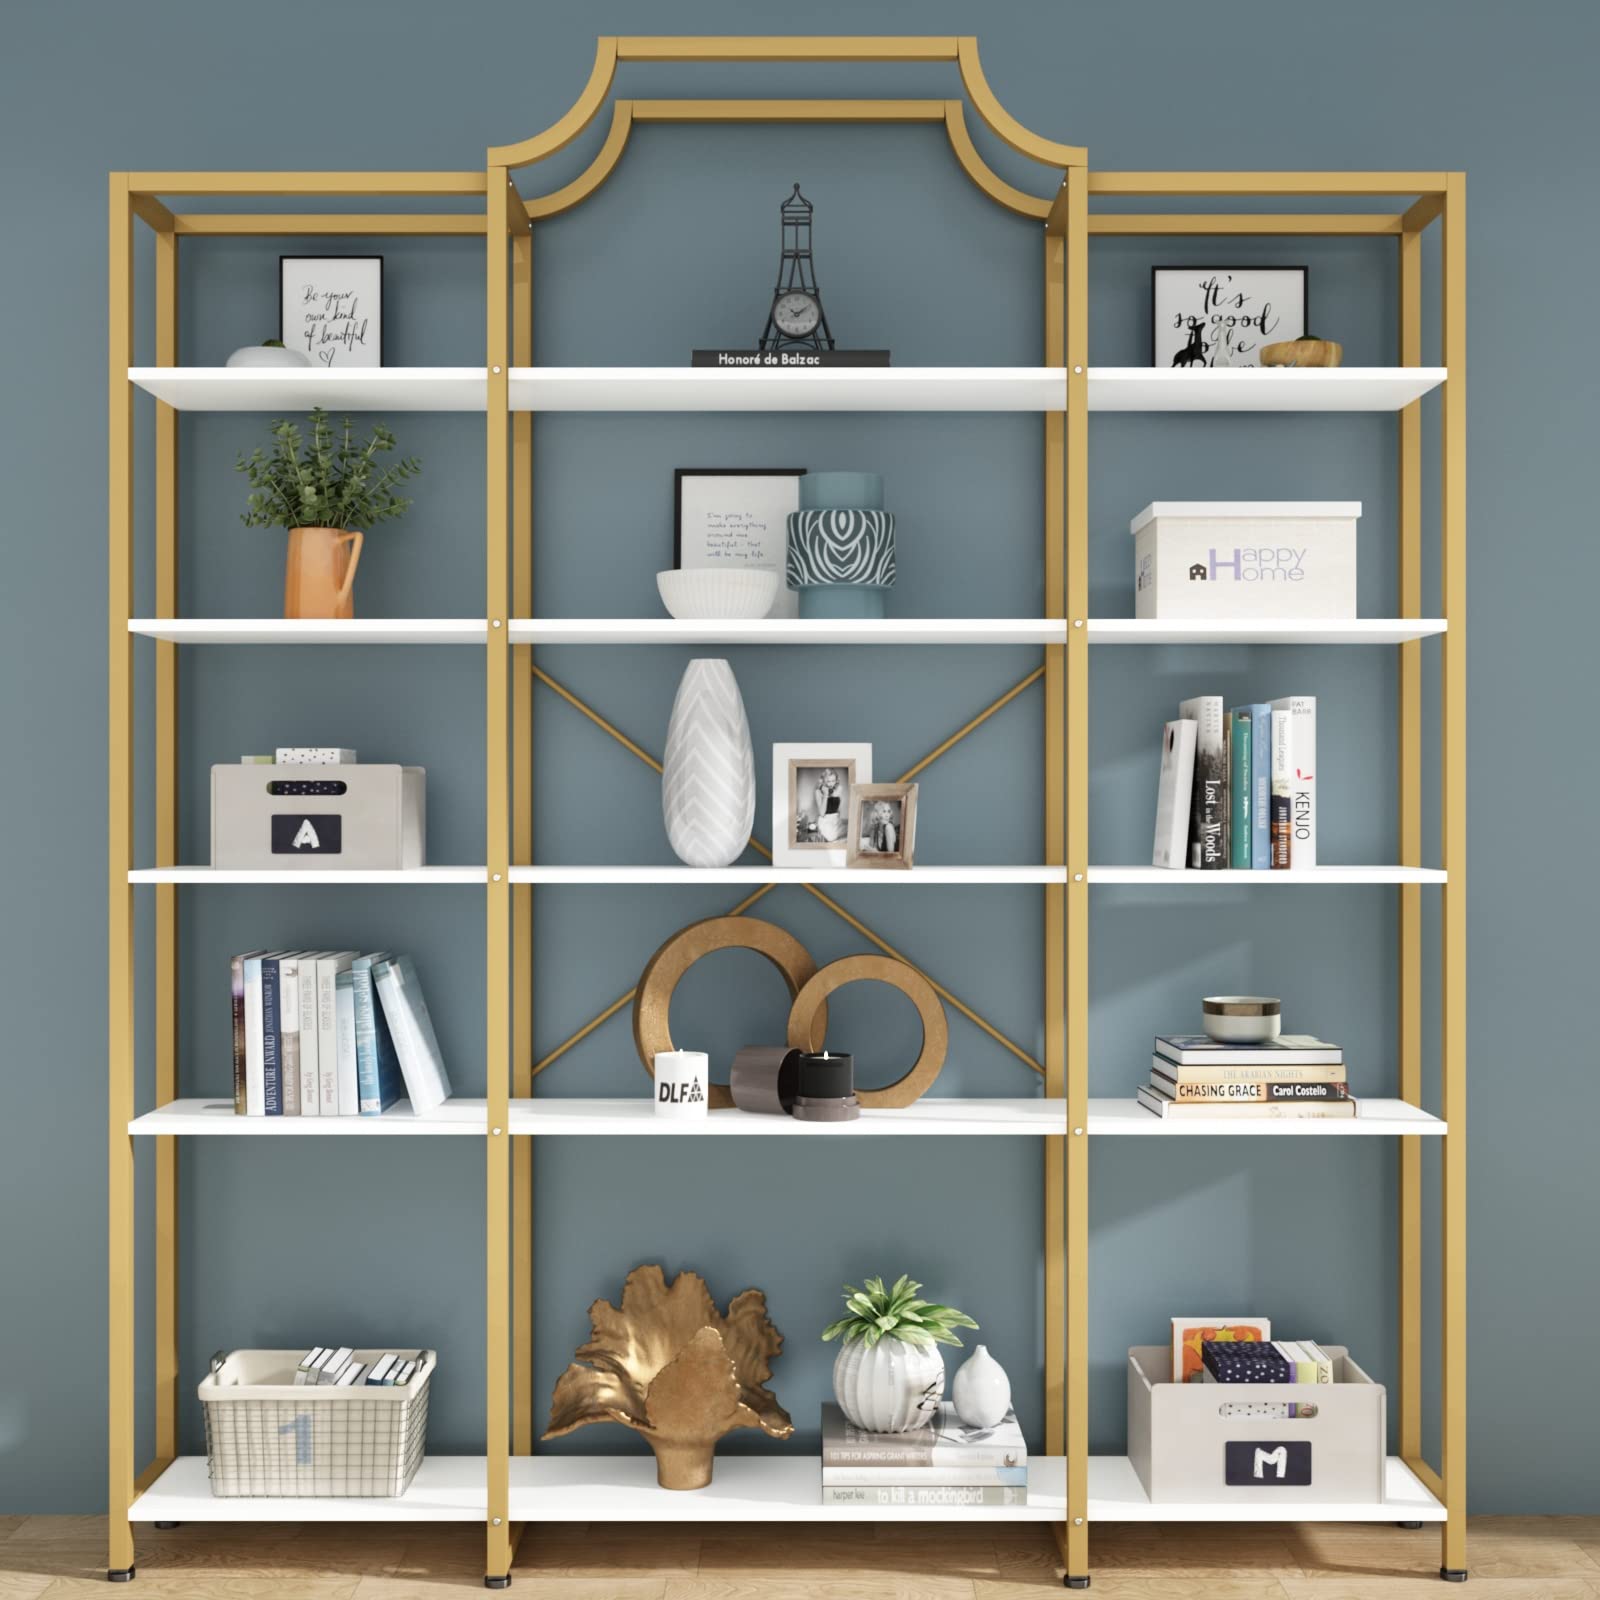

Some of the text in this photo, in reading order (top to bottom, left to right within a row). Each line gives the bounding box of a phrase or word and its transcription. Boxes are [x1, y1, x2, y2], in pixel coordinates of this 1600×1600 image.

[303, 285, 354, 311] Be your
[1199, 275, 1251, 314] It's
[305, 297, 357, 323] own kind
[304, 318, 368, 352] of beautiful
[719, 353, 820, 366] Honoré de Balzac
[1205, 780, 1221, 804] Lost
[1295, 791, 1310, 840] KENJO
[291, 818, 321, 849] A
[1205, 822, 1221, 863] Woods
[264, 1035, 276, 1065] INWARD
[264, 1067, 277, 1112] ADVENTURE
[1179, 1084, 1262, 1097] CHASING GRACE
[1272, 1085, 1293, 1097] Carol
[1295, 1084, 1327, 1097] Costello
[277, 1413, 313, 1465] 1
[1253, 1446, 1288, 1479] M
[833, 1488, 854, 1502] harper
[877, 1487, 984, 1506] to kill a mockingbird
